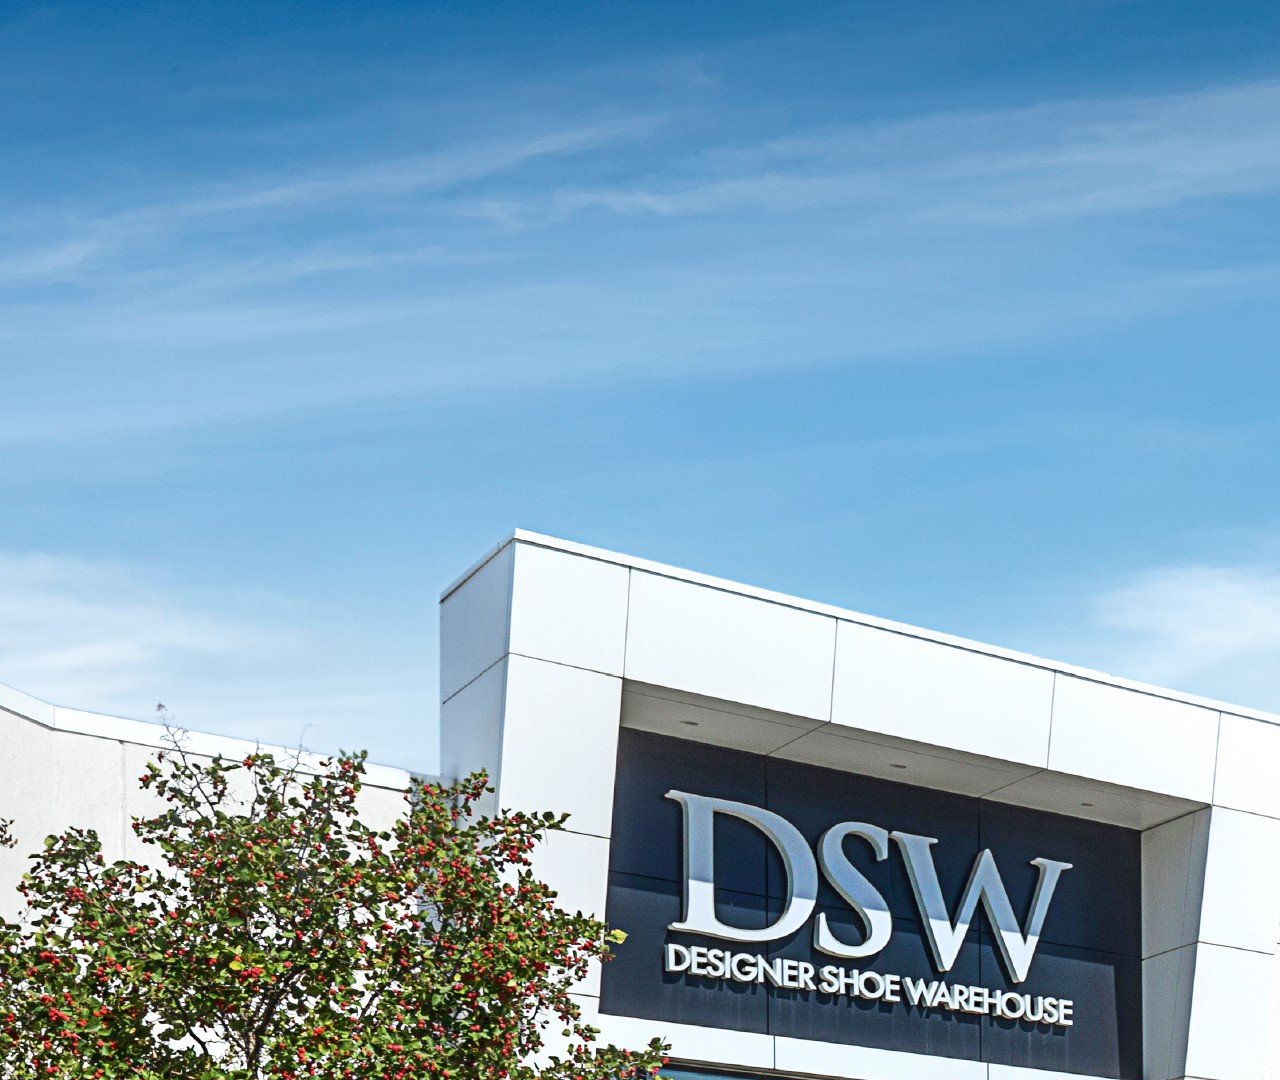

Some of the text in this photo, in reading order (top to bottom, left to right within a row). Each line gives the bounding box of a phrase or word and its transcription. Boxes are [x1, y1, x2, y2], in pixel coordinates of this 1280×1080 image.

[663, 789, 1073, 984] DSW
[665, 943, 1074, 1027] DESIGNER SHOE WAREHOUSE
